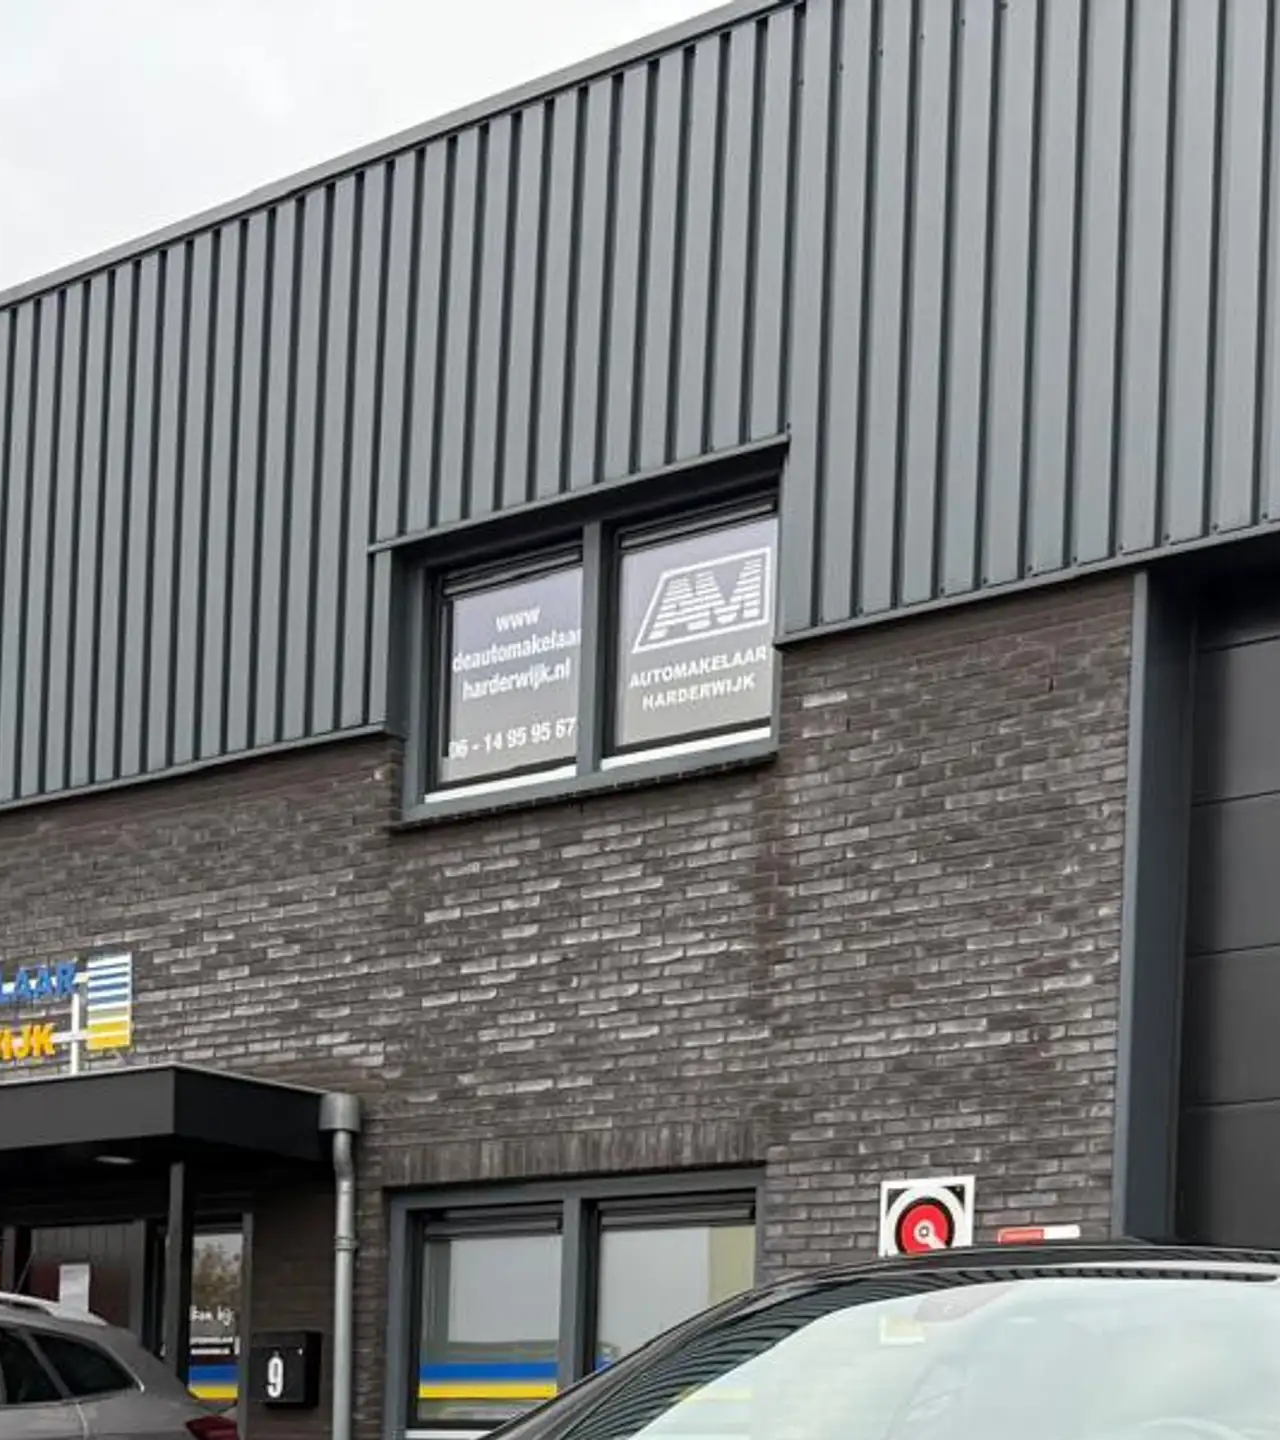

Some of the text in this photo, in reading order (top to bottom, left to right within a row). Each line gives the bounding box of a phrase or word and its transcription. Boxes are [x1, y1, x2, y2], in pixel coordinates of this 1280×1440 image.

[496, 608, 541, 632] www
[463, 657, 570, 701] harderwijk.nl
[630, 646, 767, 688] AUTOMAKELAAR
[642, 673, 756, 710] HARDERWIJK
[484, 732, 503, 753] 14
[507, 726, 527, 748] 95
[531, 721, 552, 743] 95
[267, 1356, 284, 1397] 9
